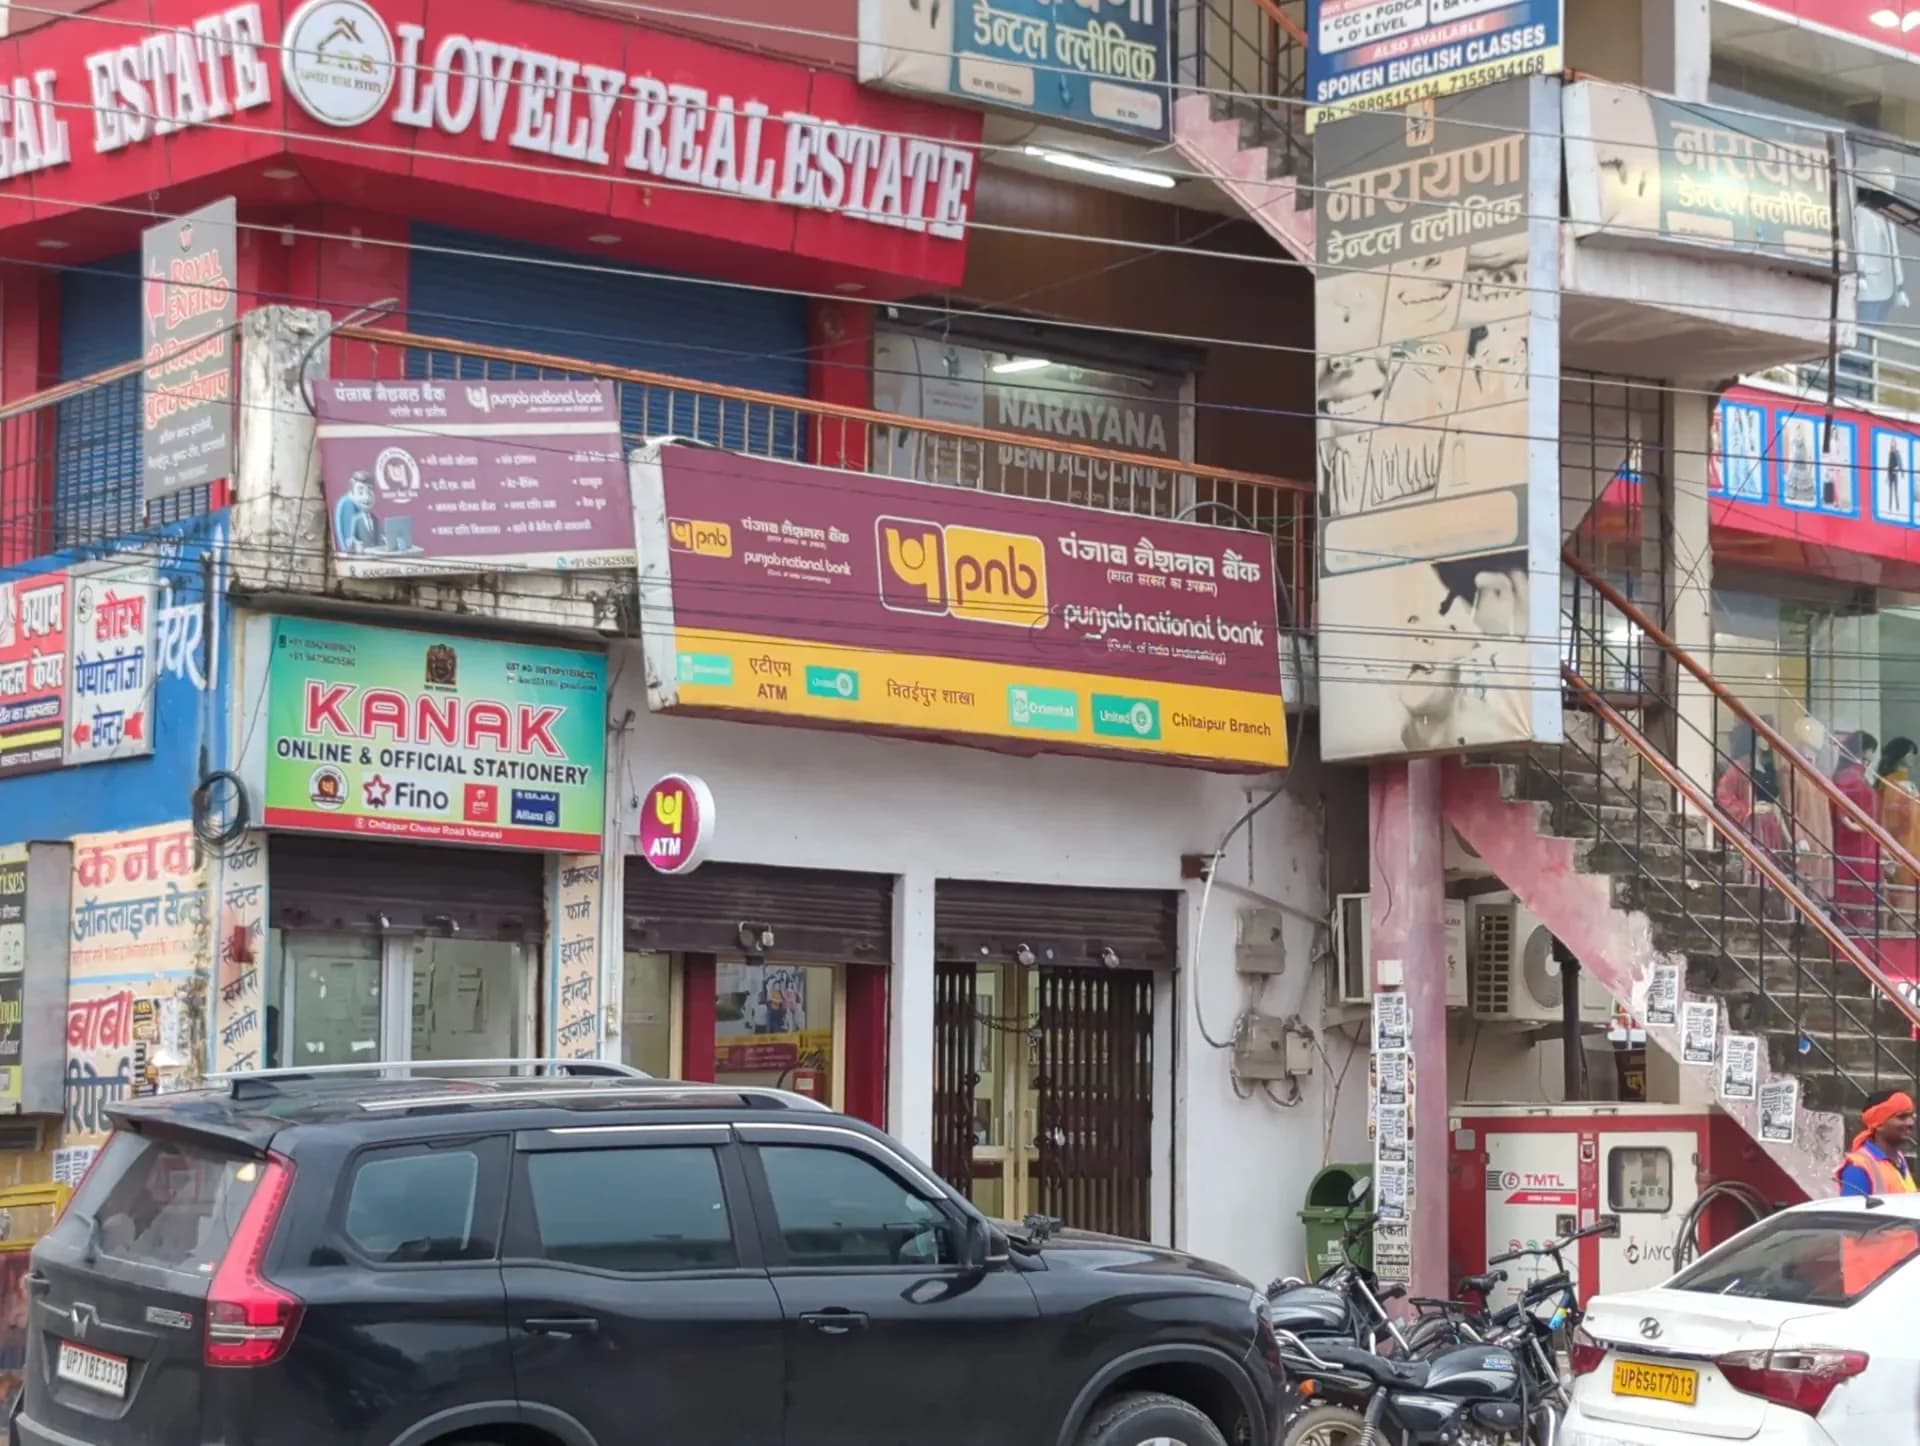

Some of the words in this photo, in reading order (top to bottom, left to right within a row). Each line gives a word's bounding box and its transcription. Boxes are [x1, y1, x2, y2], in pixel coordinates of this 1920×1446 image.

[1334, 10, 1361, 29] CCC
[1365, 17, 1407, 37] LEVEL
[1373, 41, 1408, 59] ALSO
[1413, 18, 1486, 47] AVAILABLE
[1317, 70, 1384, 101] SPOKEN
[1388, 47, 1462, 81] ENGLISH
[1466, 24, 1546, 62] CLASSES
[86, 3, 272, 153] ESTATE
[392, 23, 626, 166] LOVELY
[624, 76, 774, 200] REAL
[777, 111, 974, 241] ESTATE
[170, 249, 222, 288] ROYAL
[166, 278, 230, 328] ENFIELD
[1000, 392, 1167, 452] NARAYANA
[696, 527, 728, 549] pnb
[741, 516, 778, 535] पंजाब
[828, 525, 849, 544] बैंक
[744, 551, 782, 568] punjab
[782, 556, 824, 572] national
[825, 559, 851, 576] bank
[1058, 531, 1127, 565] पंजाब
[1135, 538, 1214, 577] नैशनल
[1222, 549, 1261, 583] बैंक
[956, 545, 1038, 606] pnb
[1170, 577, 1181, 590] का
[1064, 604, 1132, 634] punjab
[1135, 610, 1215, 640] national
[1218, 617, 1264, 646] bank
[749, 655, 792, 678] एटीएम
[757, 683, 788, 700] ATM
[887, 679, 936, 706] चितईपुर
[942, 687, 975, 706] शाखा
[305, 680, 566, 758] KANAK
[1029, 702, 1074, 718] Oriental
[1100, 709, 1131, 725] United
[1172, 712, 1226, 733] Chitaipur
[1229, 717, 1272, 737] Branch
[277, 738, 351, 764] ONLINE
[359, 750, 372, 765] &
[381, 749, 466, 775] OFFICIAL
[473, 758, 589, 785] STATIONERY
[395, 783, 449, 811] Fino
[442, 826, 465, 837] Road
[650, 837, 681, 856] ATM
[68, 991, 133, 1050] बाबा
[1524, 1173, 1564, 1187] TMTL
